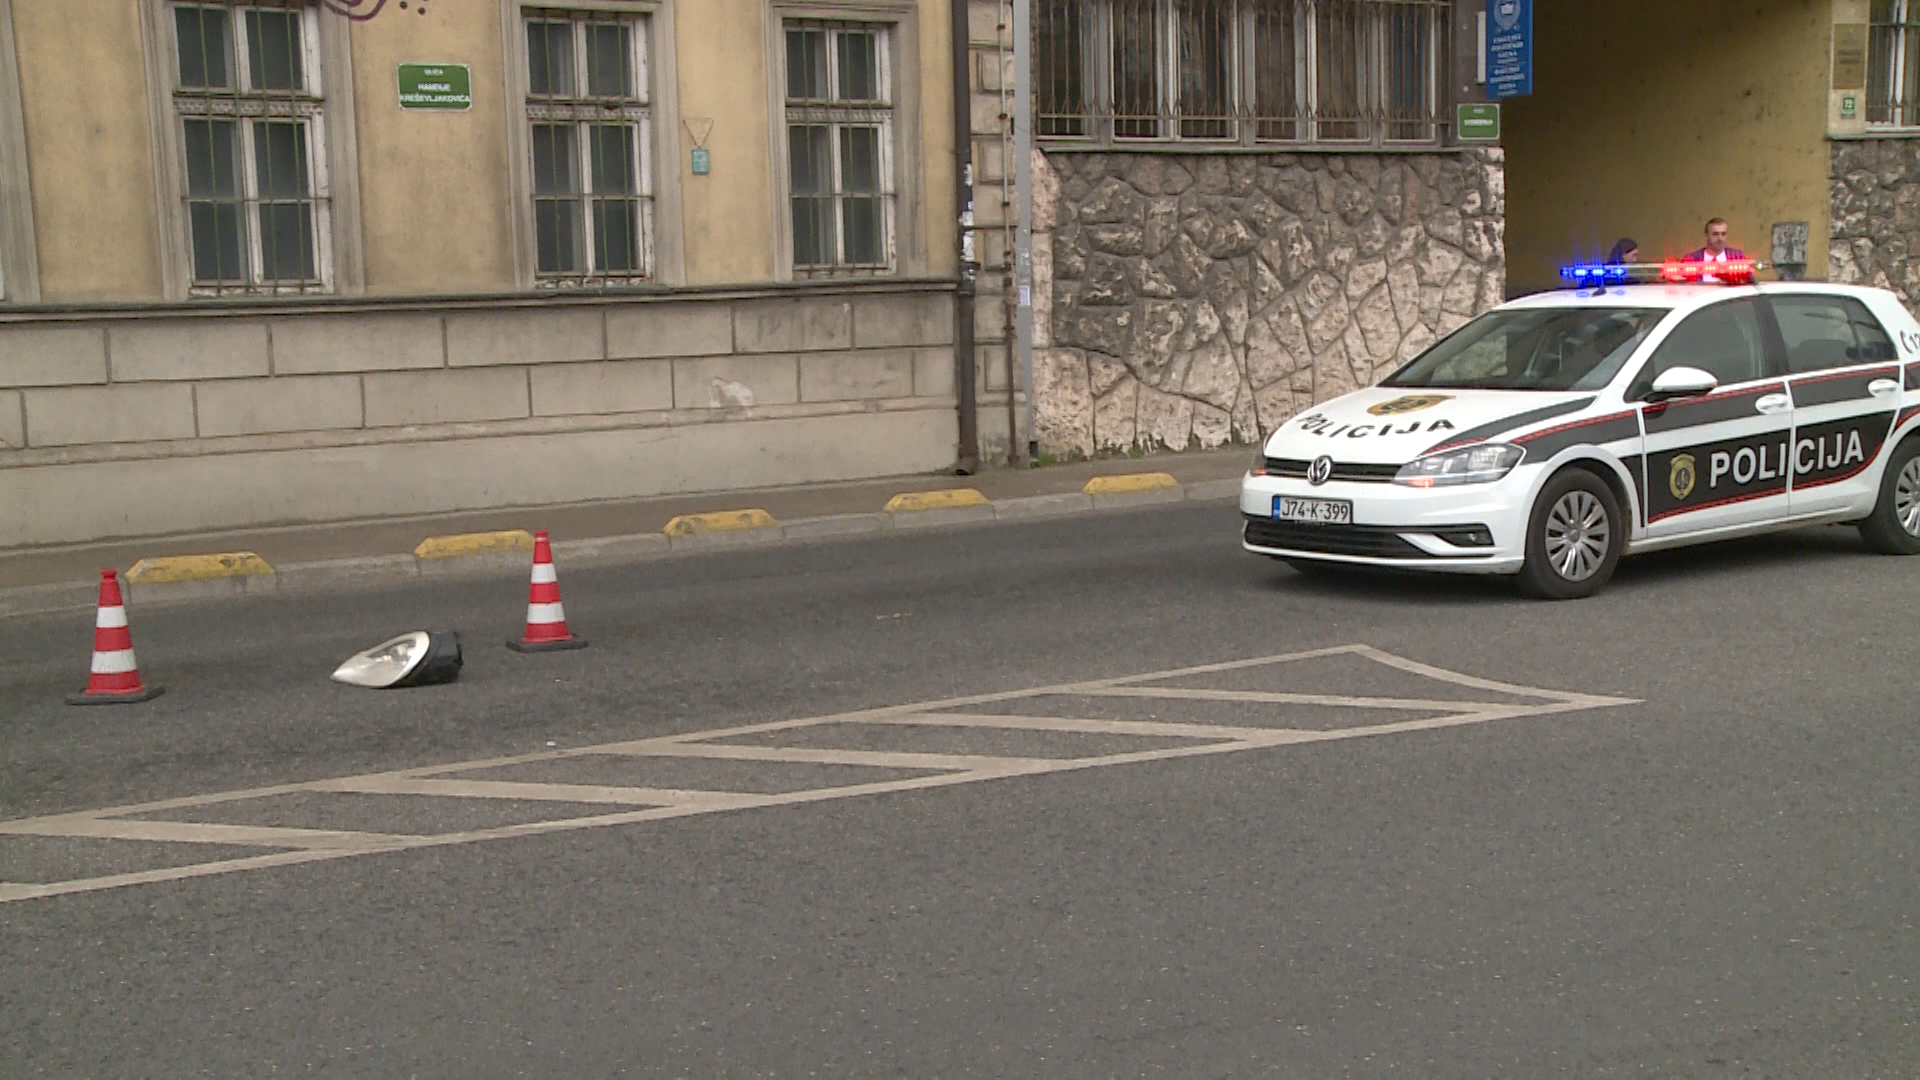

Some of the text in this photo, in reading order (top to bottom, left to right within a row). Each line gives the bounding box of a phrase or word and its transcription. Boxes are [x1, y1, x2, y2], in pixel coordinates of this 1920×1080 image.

[1297, 412, 1456, 438] POLICIJA
[1709, 429, 1864, 488] POLICIJA
[1281, 500, 1349, 520] J74-K-399
